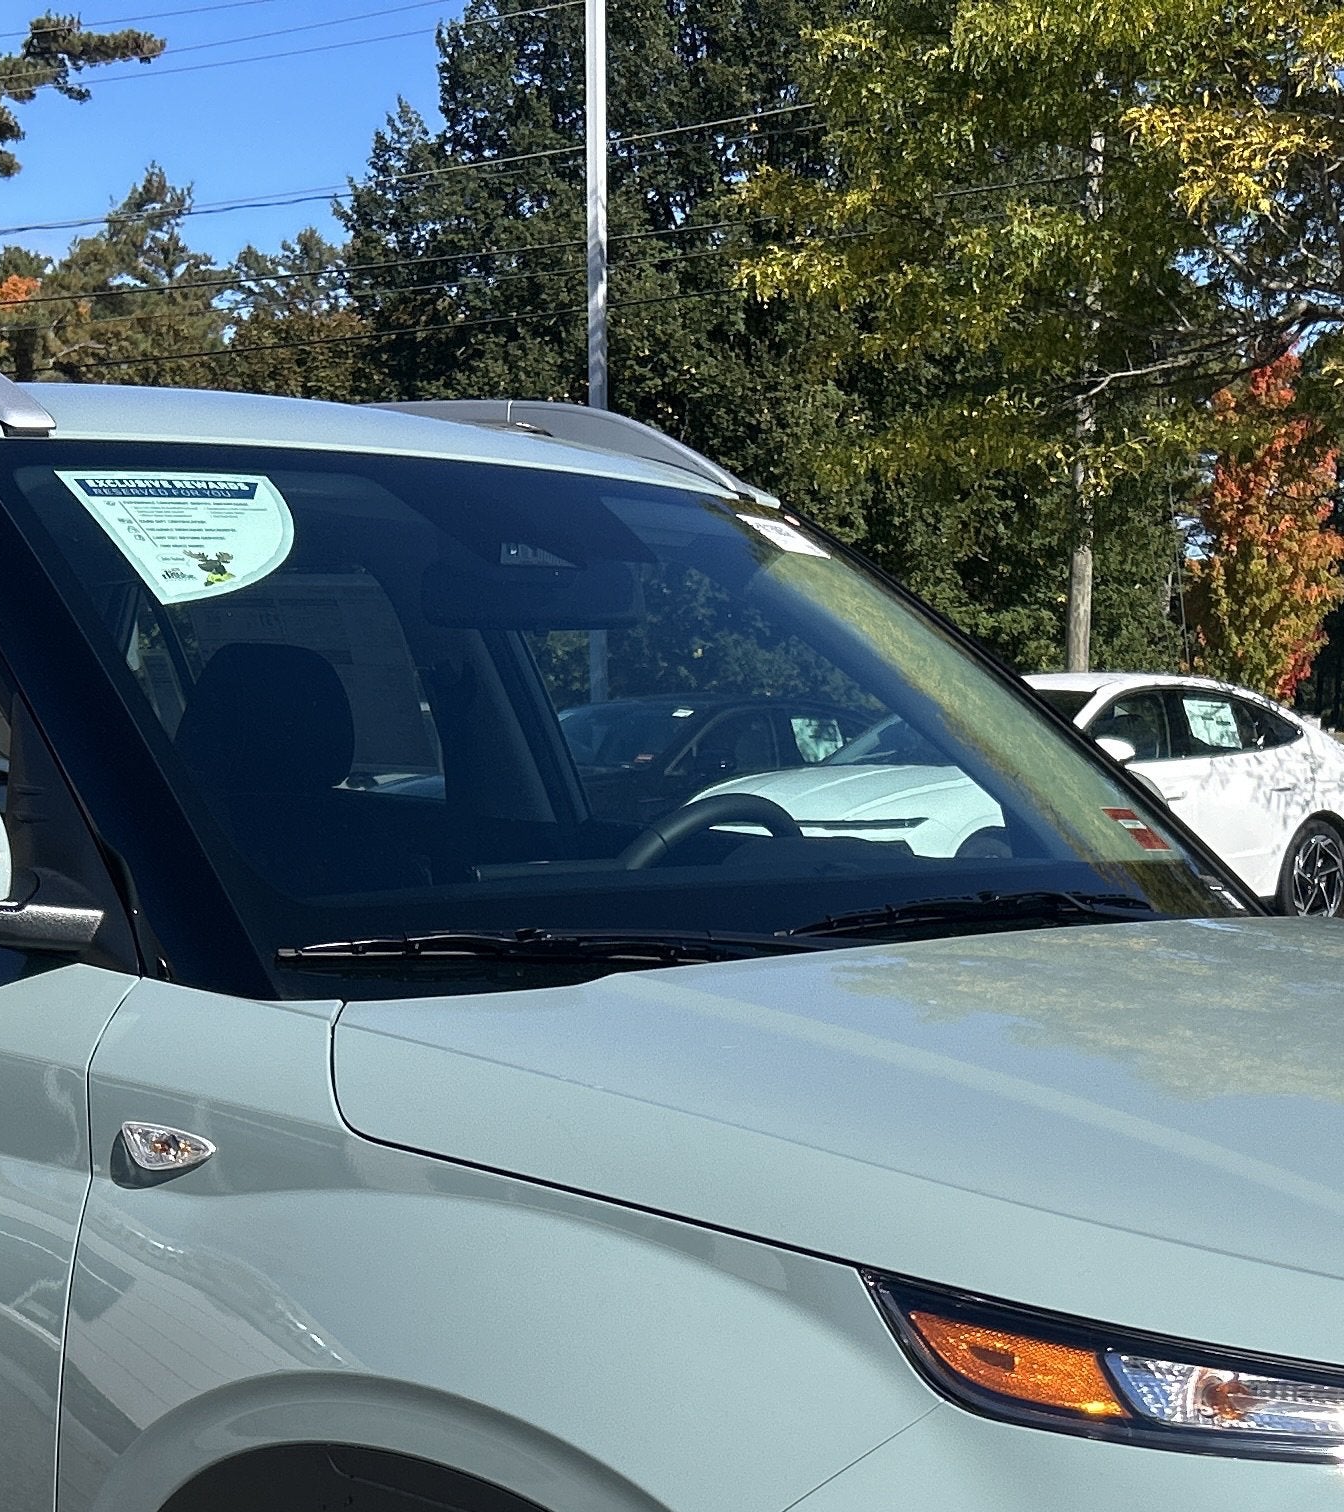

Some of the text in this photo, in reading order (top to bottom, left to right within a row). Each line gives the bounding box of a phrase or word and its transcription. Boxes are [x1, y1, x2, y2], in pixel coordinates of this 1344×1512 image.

[85, 479, 250, 491] EXCLUSIVE REWARDS
[92, 487, 232, 498] RESERVED FOR YOU
